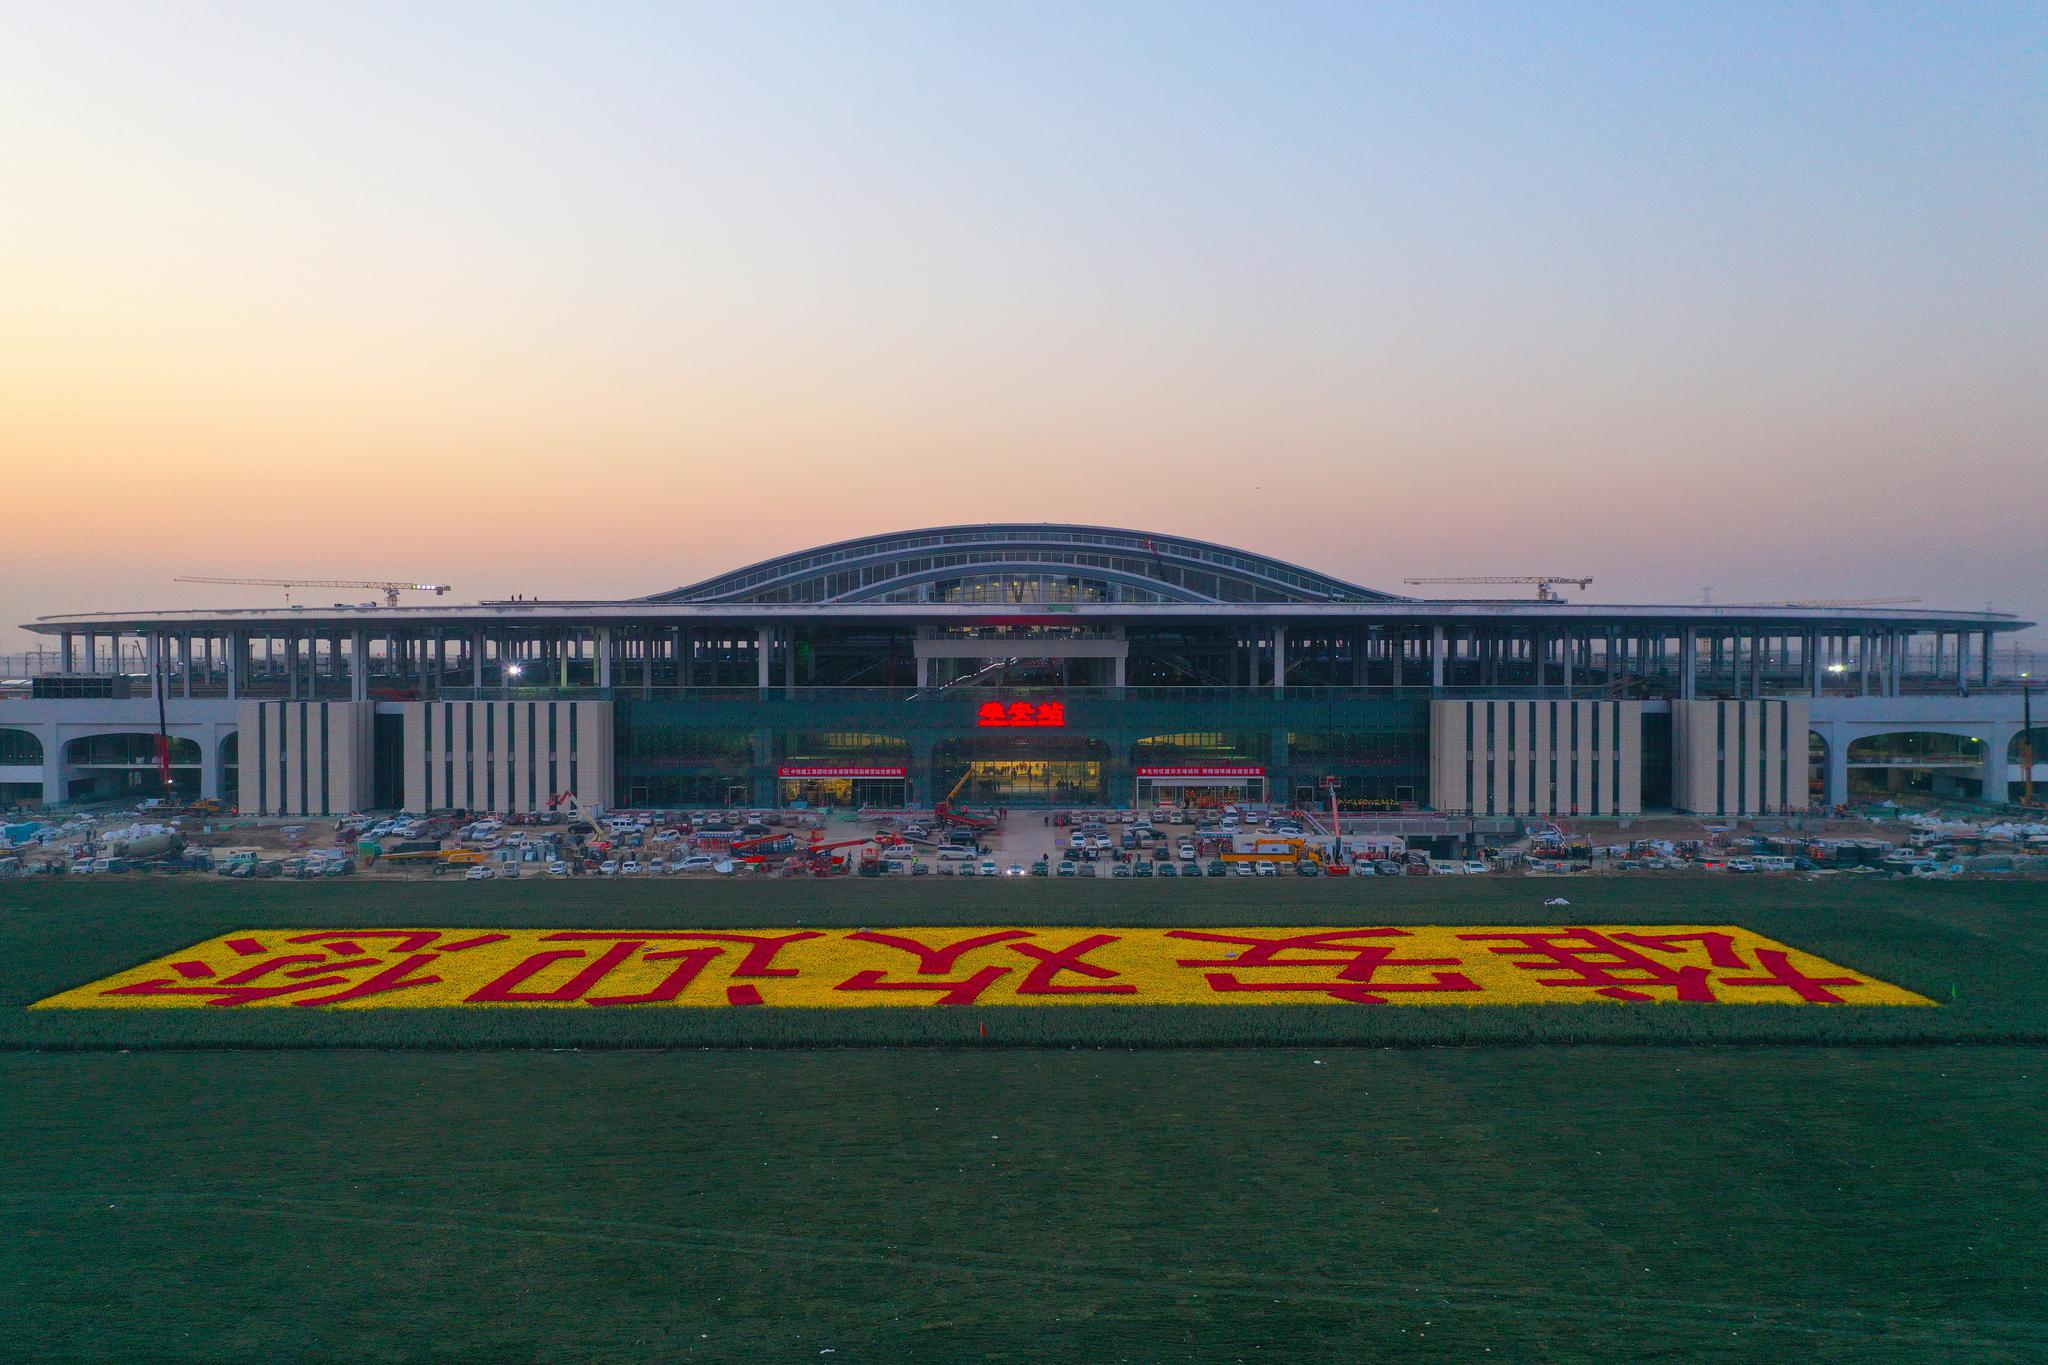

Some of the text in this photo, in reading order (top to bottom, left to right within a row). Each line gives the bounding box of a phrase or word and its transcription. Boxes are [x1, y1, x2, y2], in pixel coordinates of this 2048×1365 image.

[977, 701, 1065, 721] 雄安站
[103, 928, 1861, 1006] 雄安欢迎您
